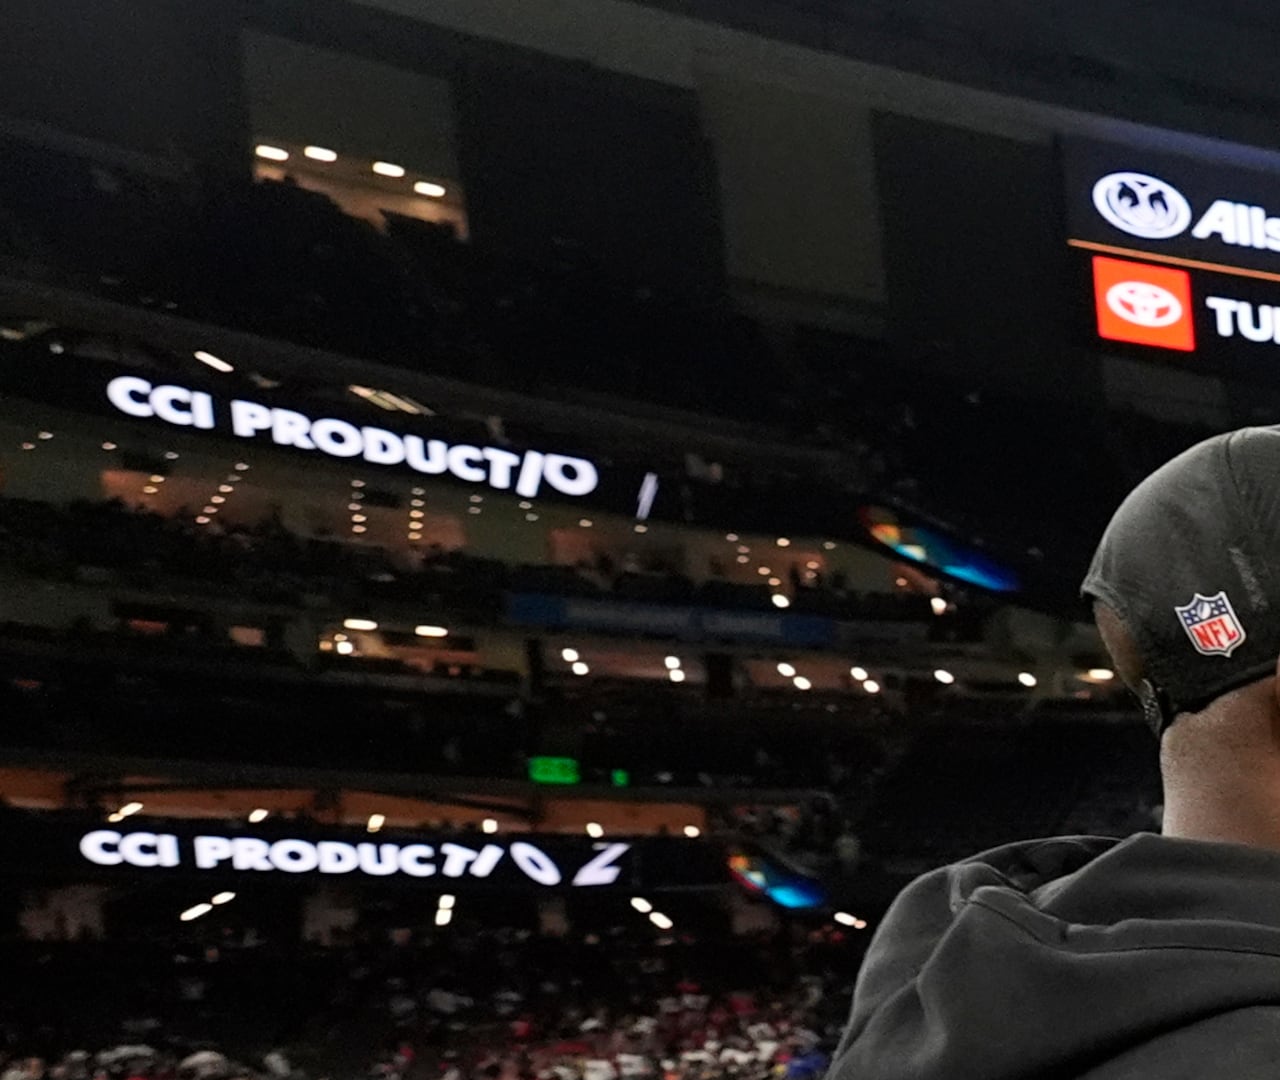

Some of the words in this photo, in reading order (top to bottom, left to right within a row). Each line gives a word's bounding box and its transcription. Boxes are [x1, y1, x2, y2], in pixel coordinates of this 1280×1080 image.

[107, 376, 214, 429] CCI
[1191, 617, 1238, 649] NFL
[79, 830, 180, 867] CCI
